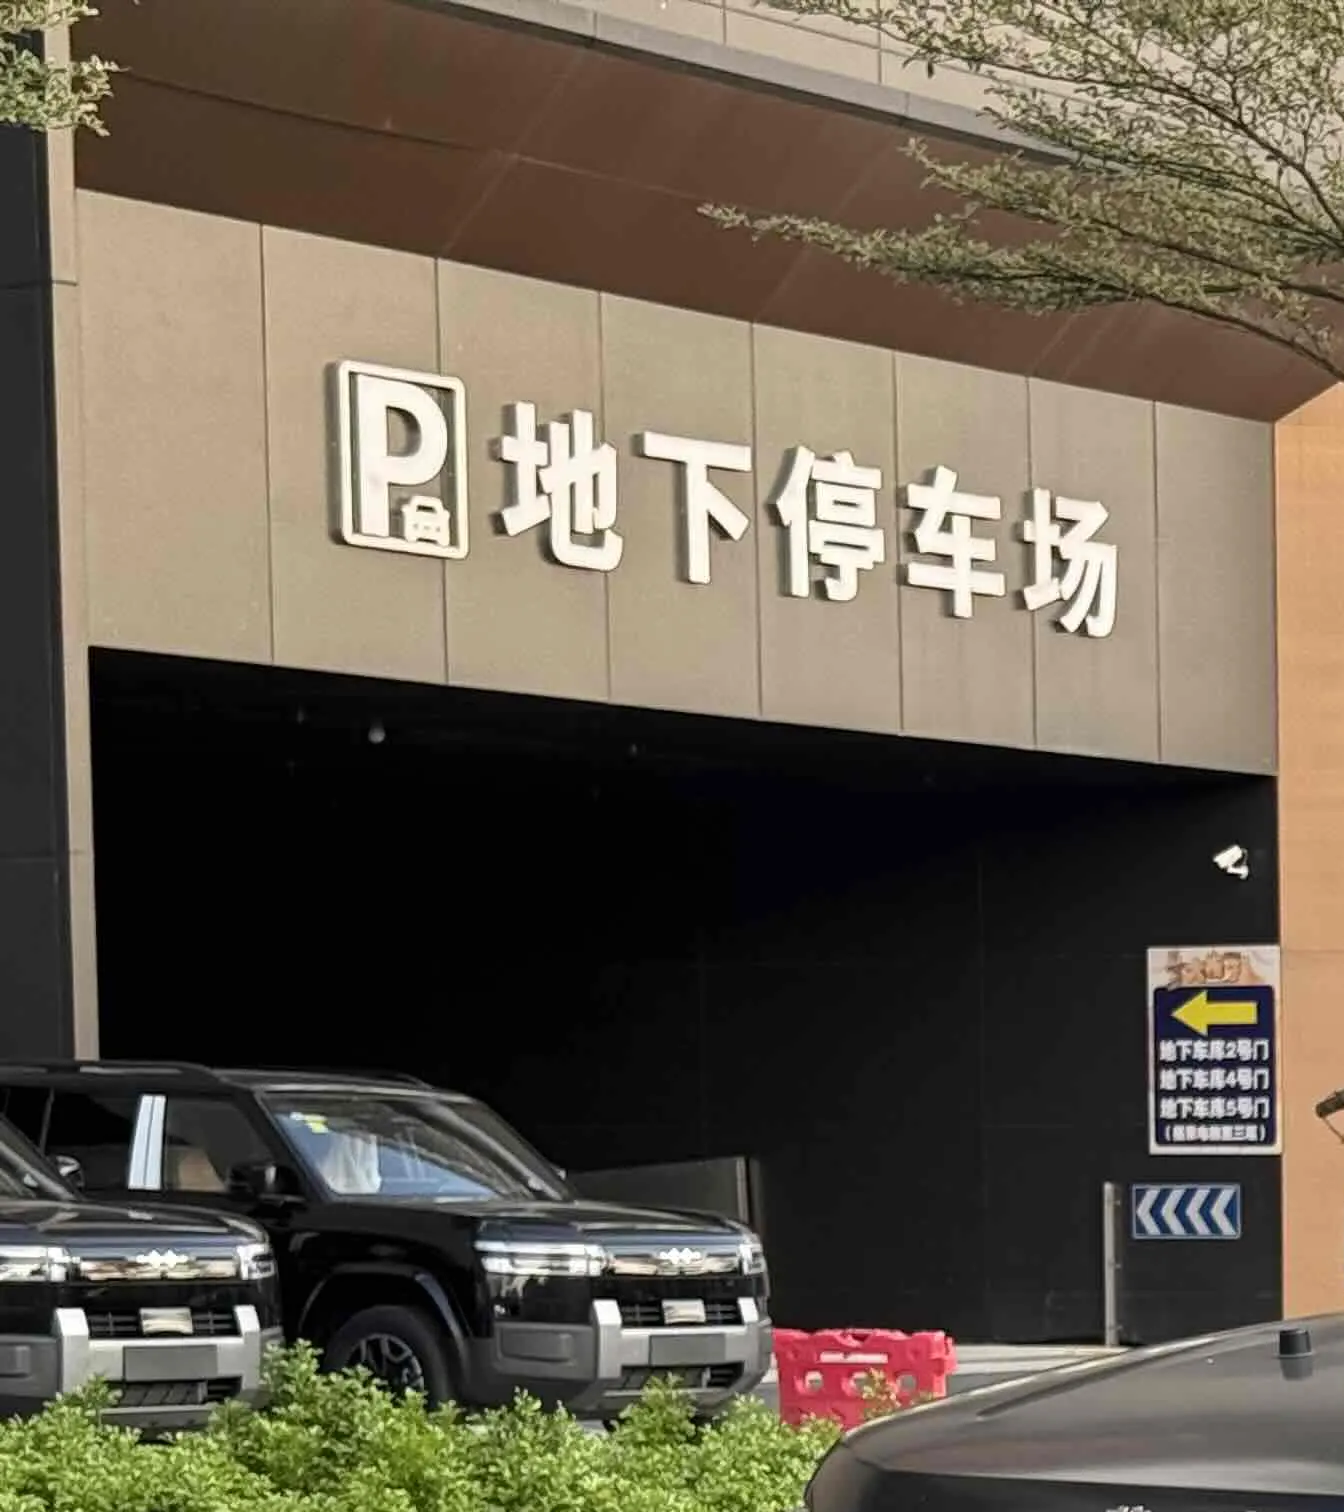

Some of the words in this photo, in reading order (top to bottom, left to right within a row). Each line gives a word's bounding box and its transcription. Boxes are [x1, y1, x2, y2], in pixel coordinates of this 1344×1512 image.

[356, 373, 448, 538] P
[498, 401, 1118, 638] 地下停车场
